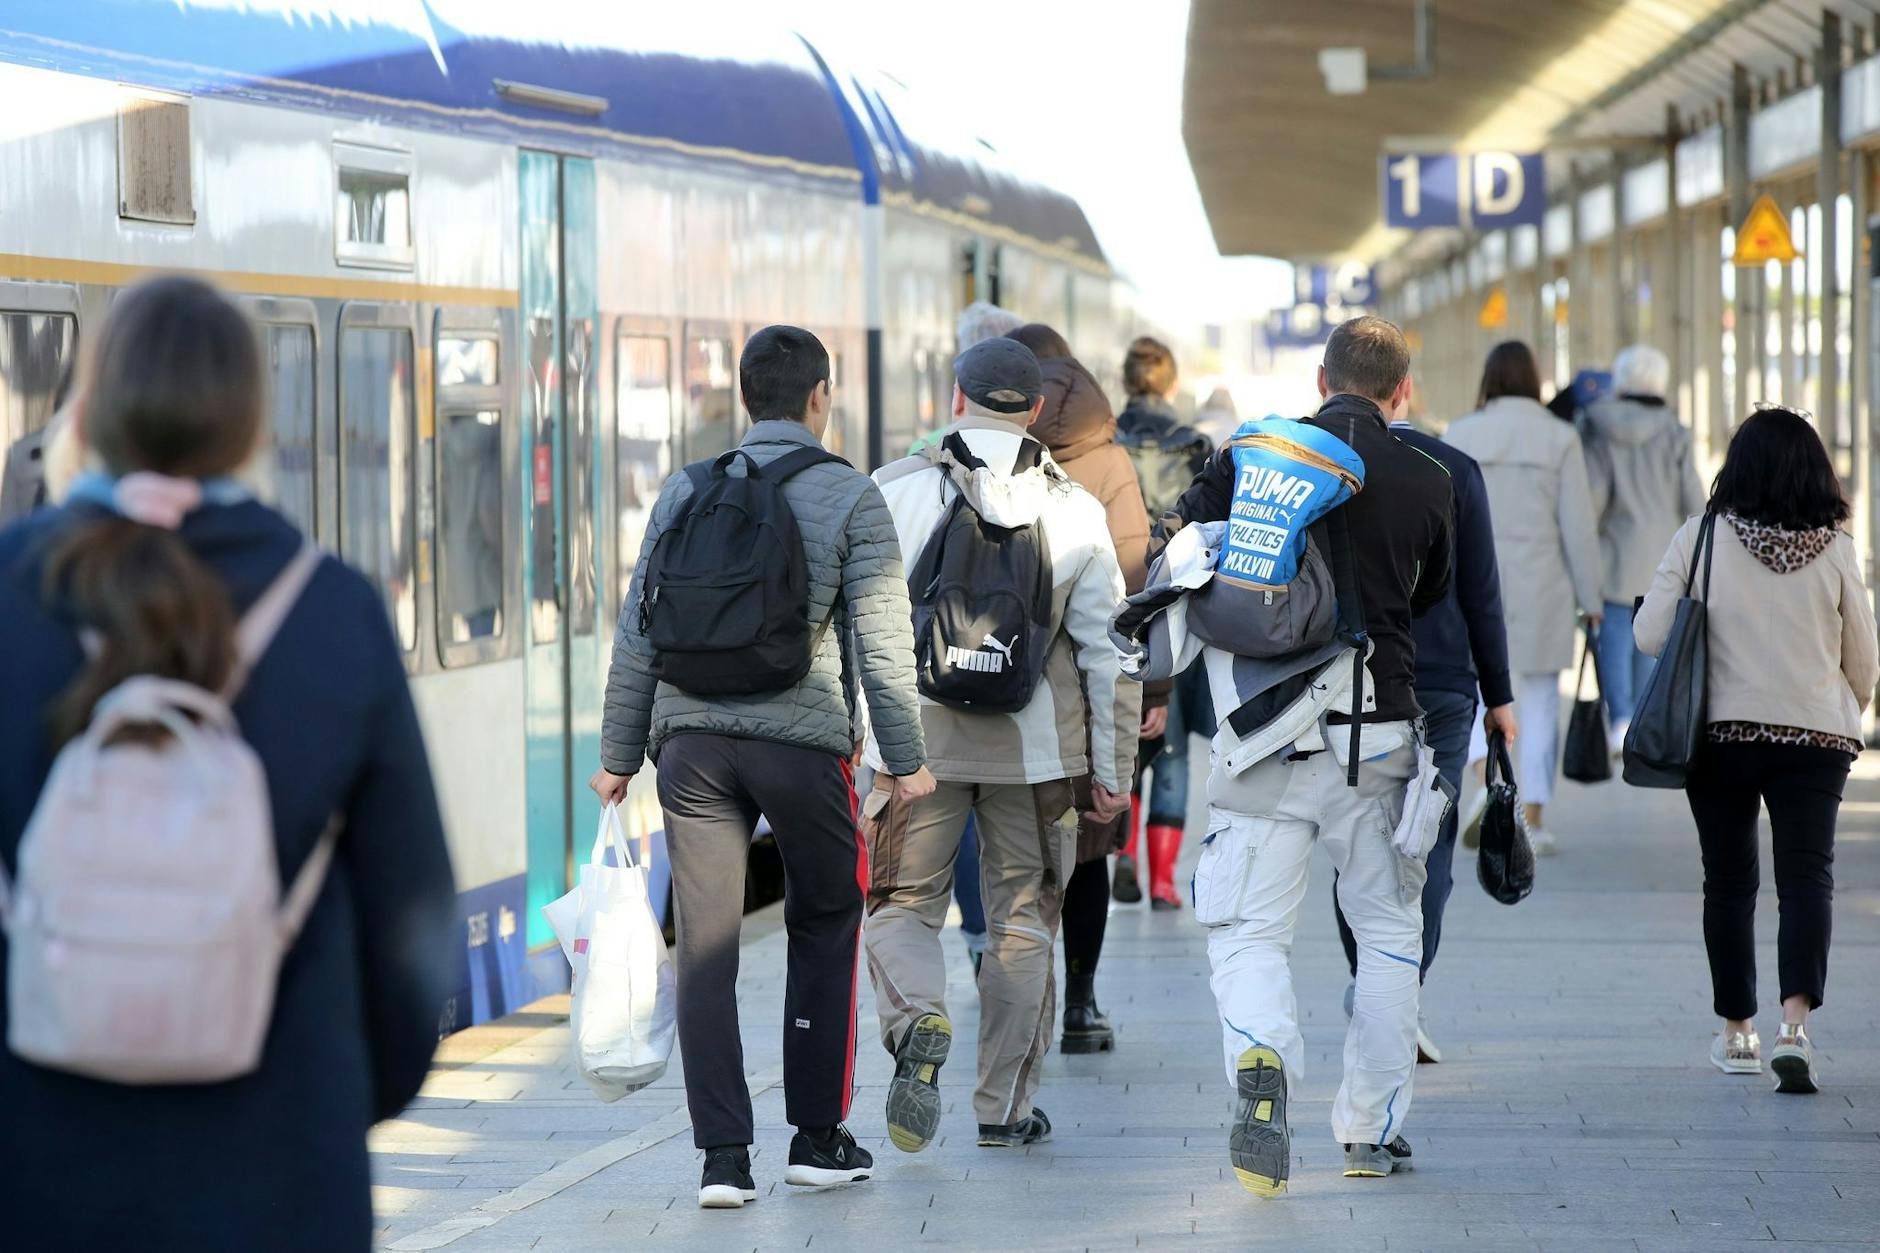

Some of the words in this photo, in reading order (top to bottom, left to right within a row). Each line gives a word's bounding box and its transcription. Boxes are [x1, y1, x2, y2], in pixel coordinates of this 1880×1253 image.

[1389, 154, 1420, 217] 1
[1474, 151, 1525, 215] D
[1237, 466, 1315, 509] PUMA
[1232, 502, 1277, 521] ORIGINAL
[1231, 524, 1284, 549] THLETICS
[945, 645, 1004, 673] PUMA
